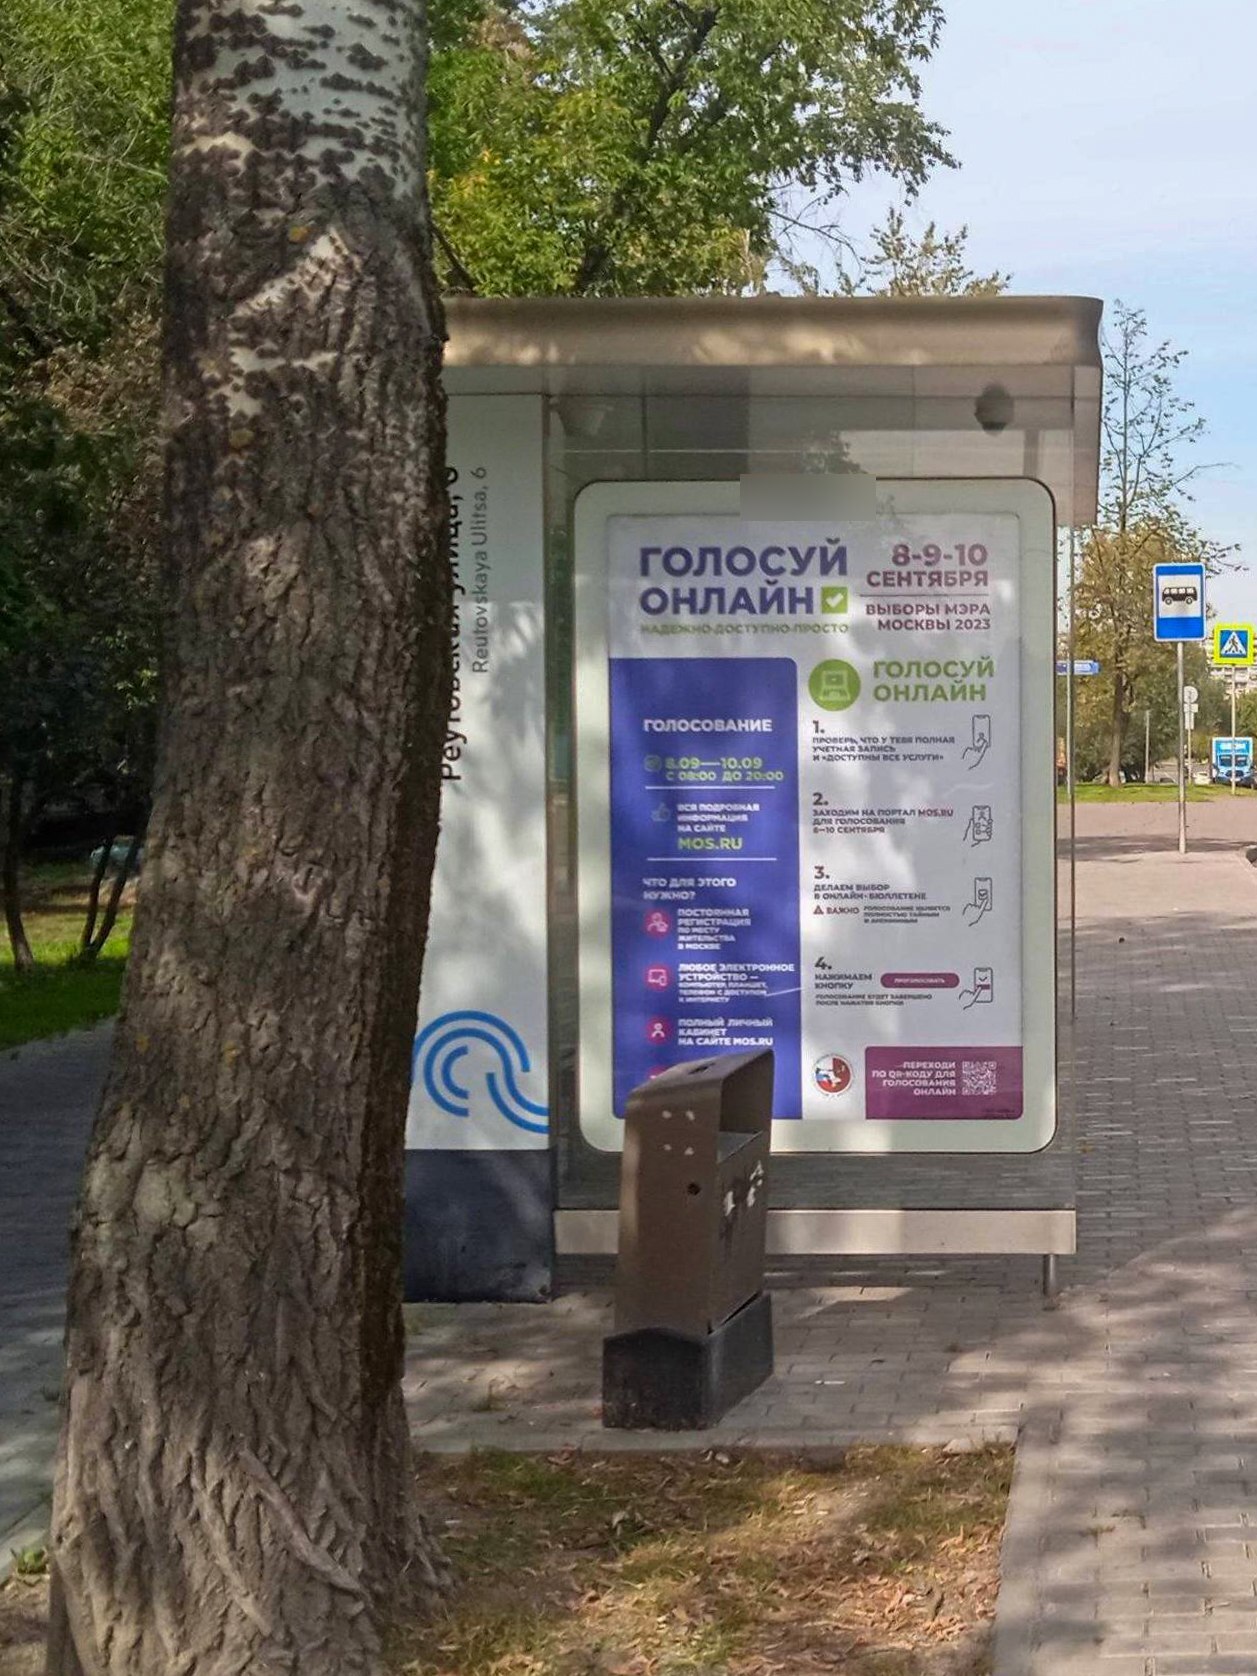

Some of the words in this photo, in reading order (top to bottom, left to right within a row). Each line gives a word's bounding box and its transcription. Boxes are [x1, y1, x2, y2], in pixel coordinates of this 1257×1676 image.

[470, 466, 486, 479] 6
[470, 485, 489, 545] Ulitsa,
[639, 537, 848, 577] ГОЛОСУЙ
[892, 543, 988, 566] 8-9-10
[866, 570, 988, 587] СЕНТЯБРЯ
[639, 579, 814, 615] ОНЛАЙН
[472, 550, 491, 672] Reutovskaya
[866, 604, 940, 615] ВЫБОРЫ
[945, 603, 990, 615] МЭРА
[877, 619, 950, 631] МОСКВЫ
[954, 619, 991, 631] 2023
[873, 656, 994, 678] ГОЛОСУЙ
[873, 680, 987, 702] ОНЛАЙН
[644, 719, 773, 732] ГОЛОСОВАНИЕ
[812, 720, 825, 734] 1.
[812, 792, 829, 806] 2.
[678, 837, 742, 850] MOS.RU
[814, 866, 830, 879] 3.
[643, 878, 667, 887] ЧТО
[669, 878, 695, 888] ДЛЯ
[698, 878, 737, 887] ЭТОГО
[643, 891, 696, 900] НУЖНО?
[815, 956, 832, 970] 4.
